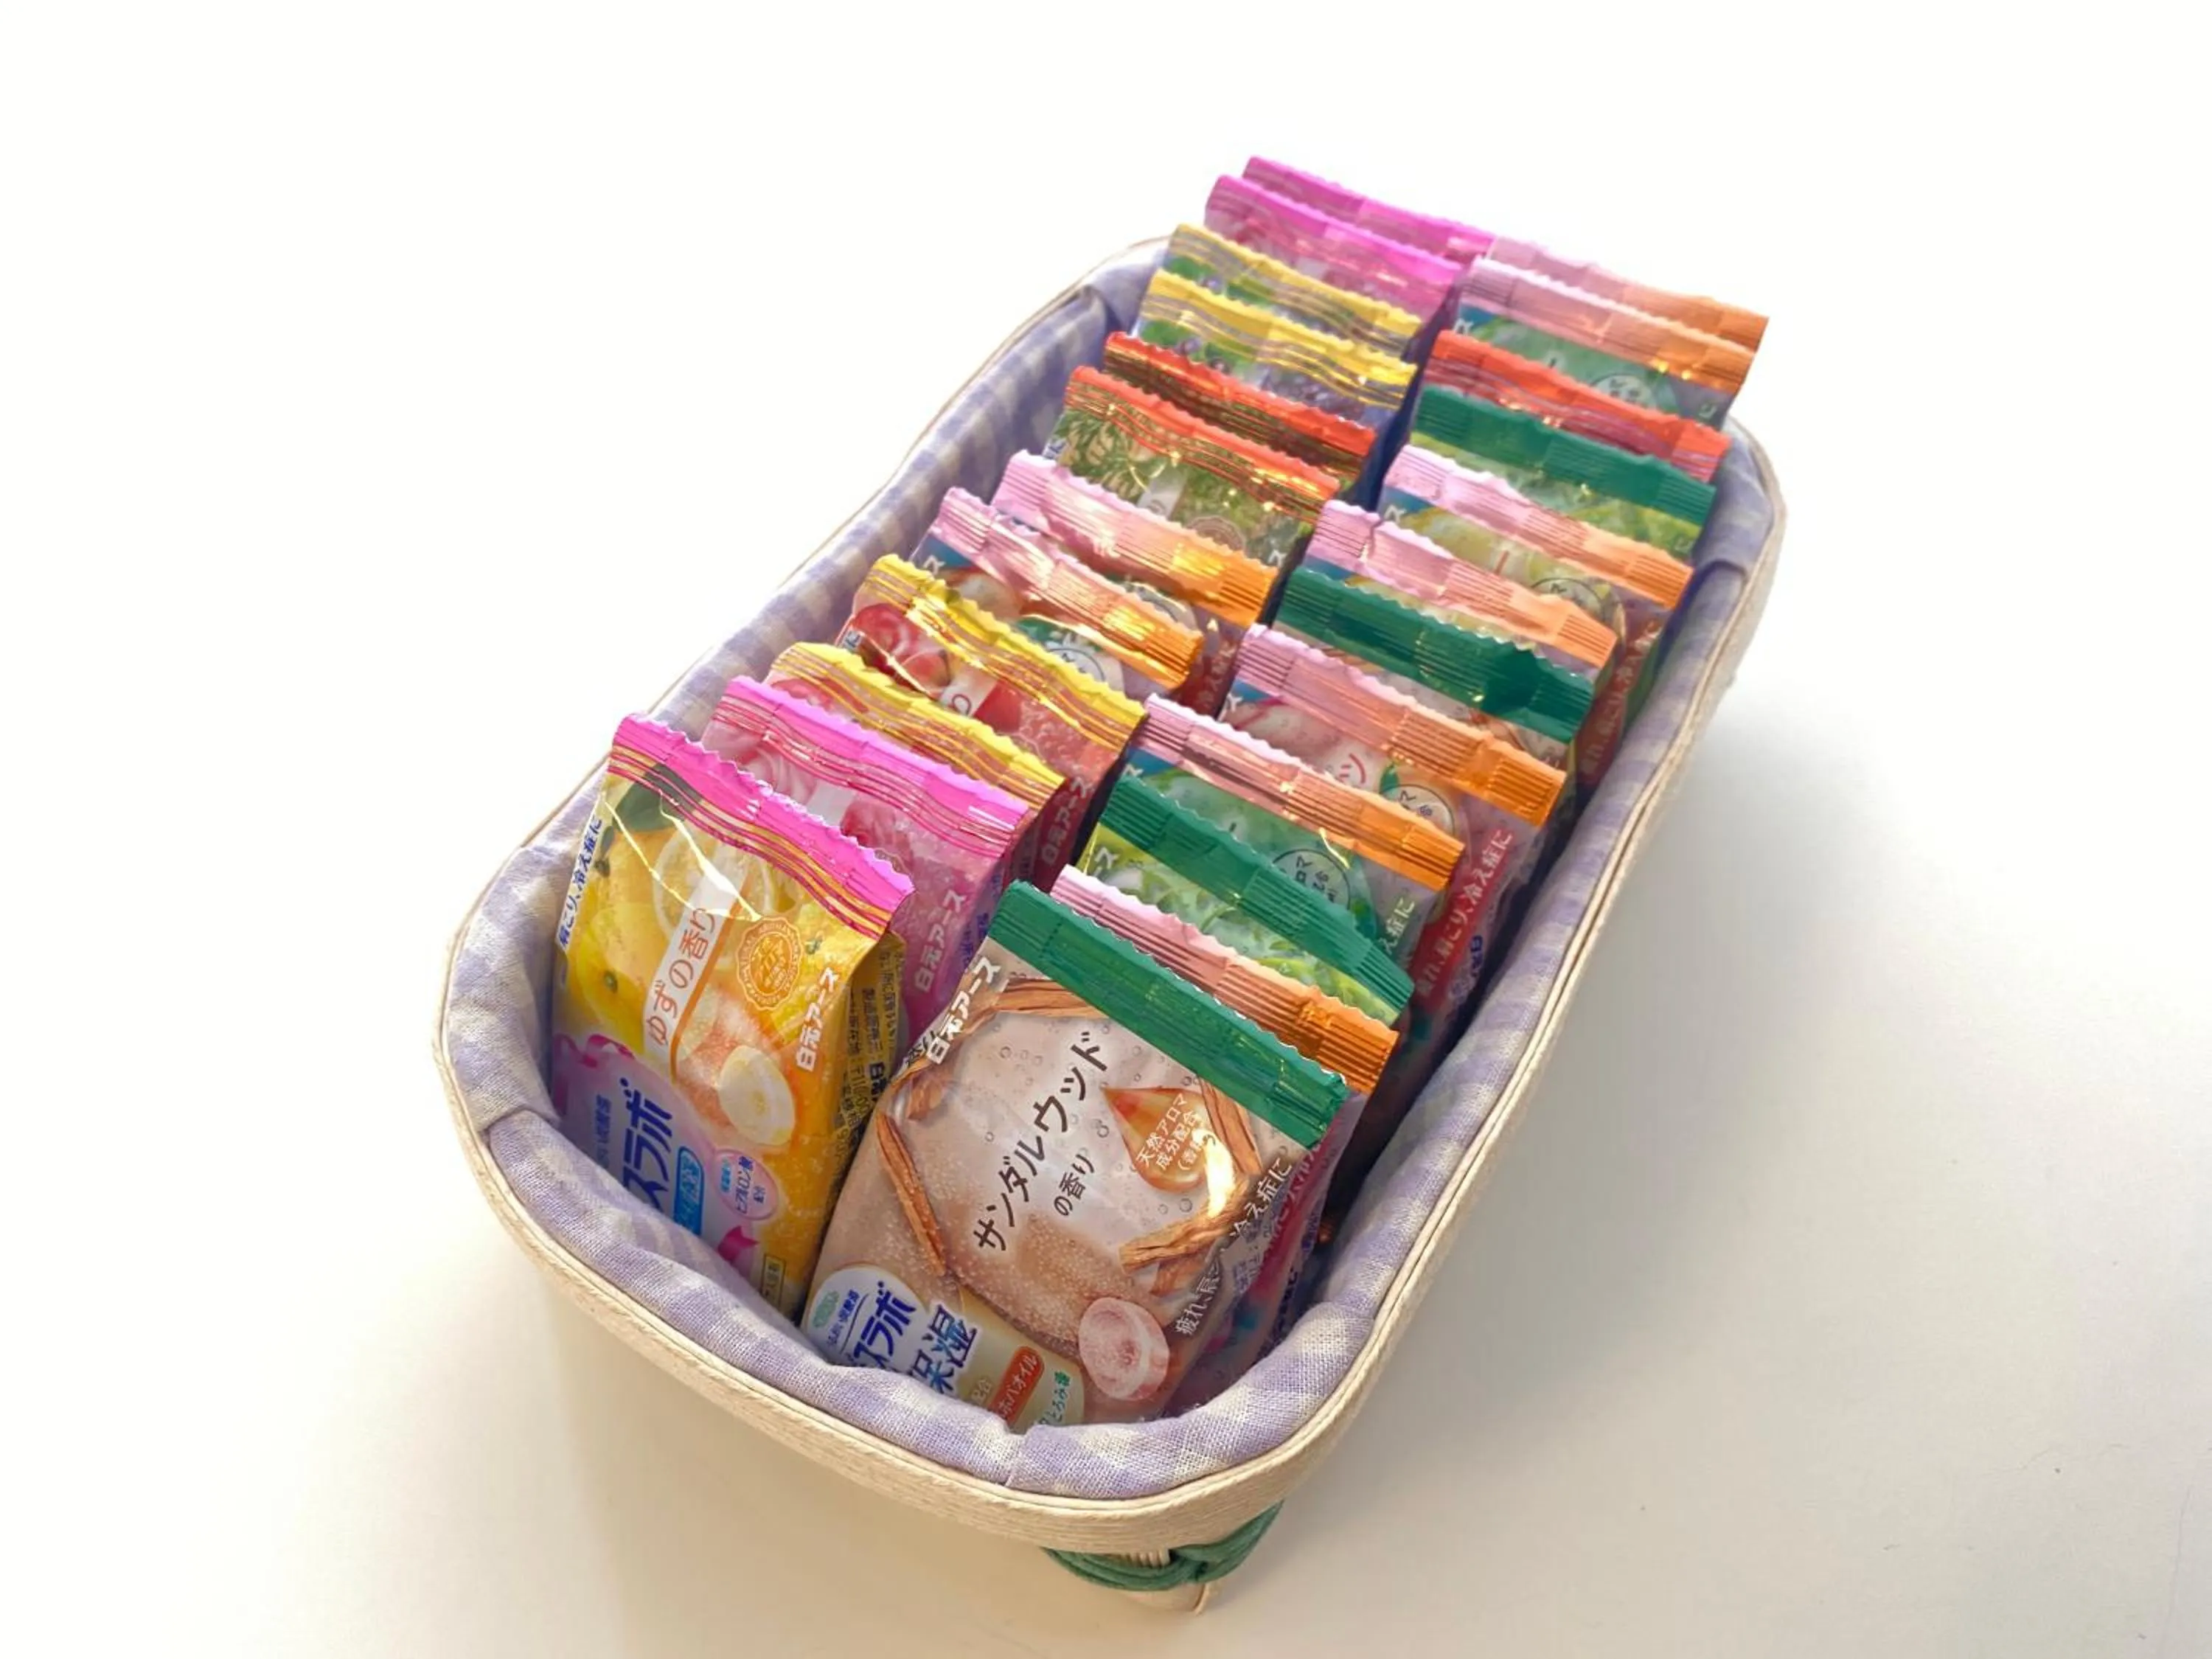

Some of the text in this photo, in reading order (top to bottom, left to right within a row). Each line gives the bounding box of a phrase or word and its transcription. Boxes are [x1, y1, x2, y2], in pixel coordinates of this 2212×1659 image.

[644, 907, 717, 1048] ゆずの香り
[914, 889, 966, 993] 白元アース
[796, 967, 839, 1069] 白元アース
[925, 956, 1001, 1065] 白元アース
[973, 1031, 1108, 1251] サンダルウッド
[1135, 1093, 1186, 1166] 天然アロマ
[1155, 1111, 1204, 1171] 成分配合
[1052, 1152, 1095, 1217] の香り
[848, 1281, 918, 1371] スラボ
[992, 1351, 1040, 1416] ホバオイル
